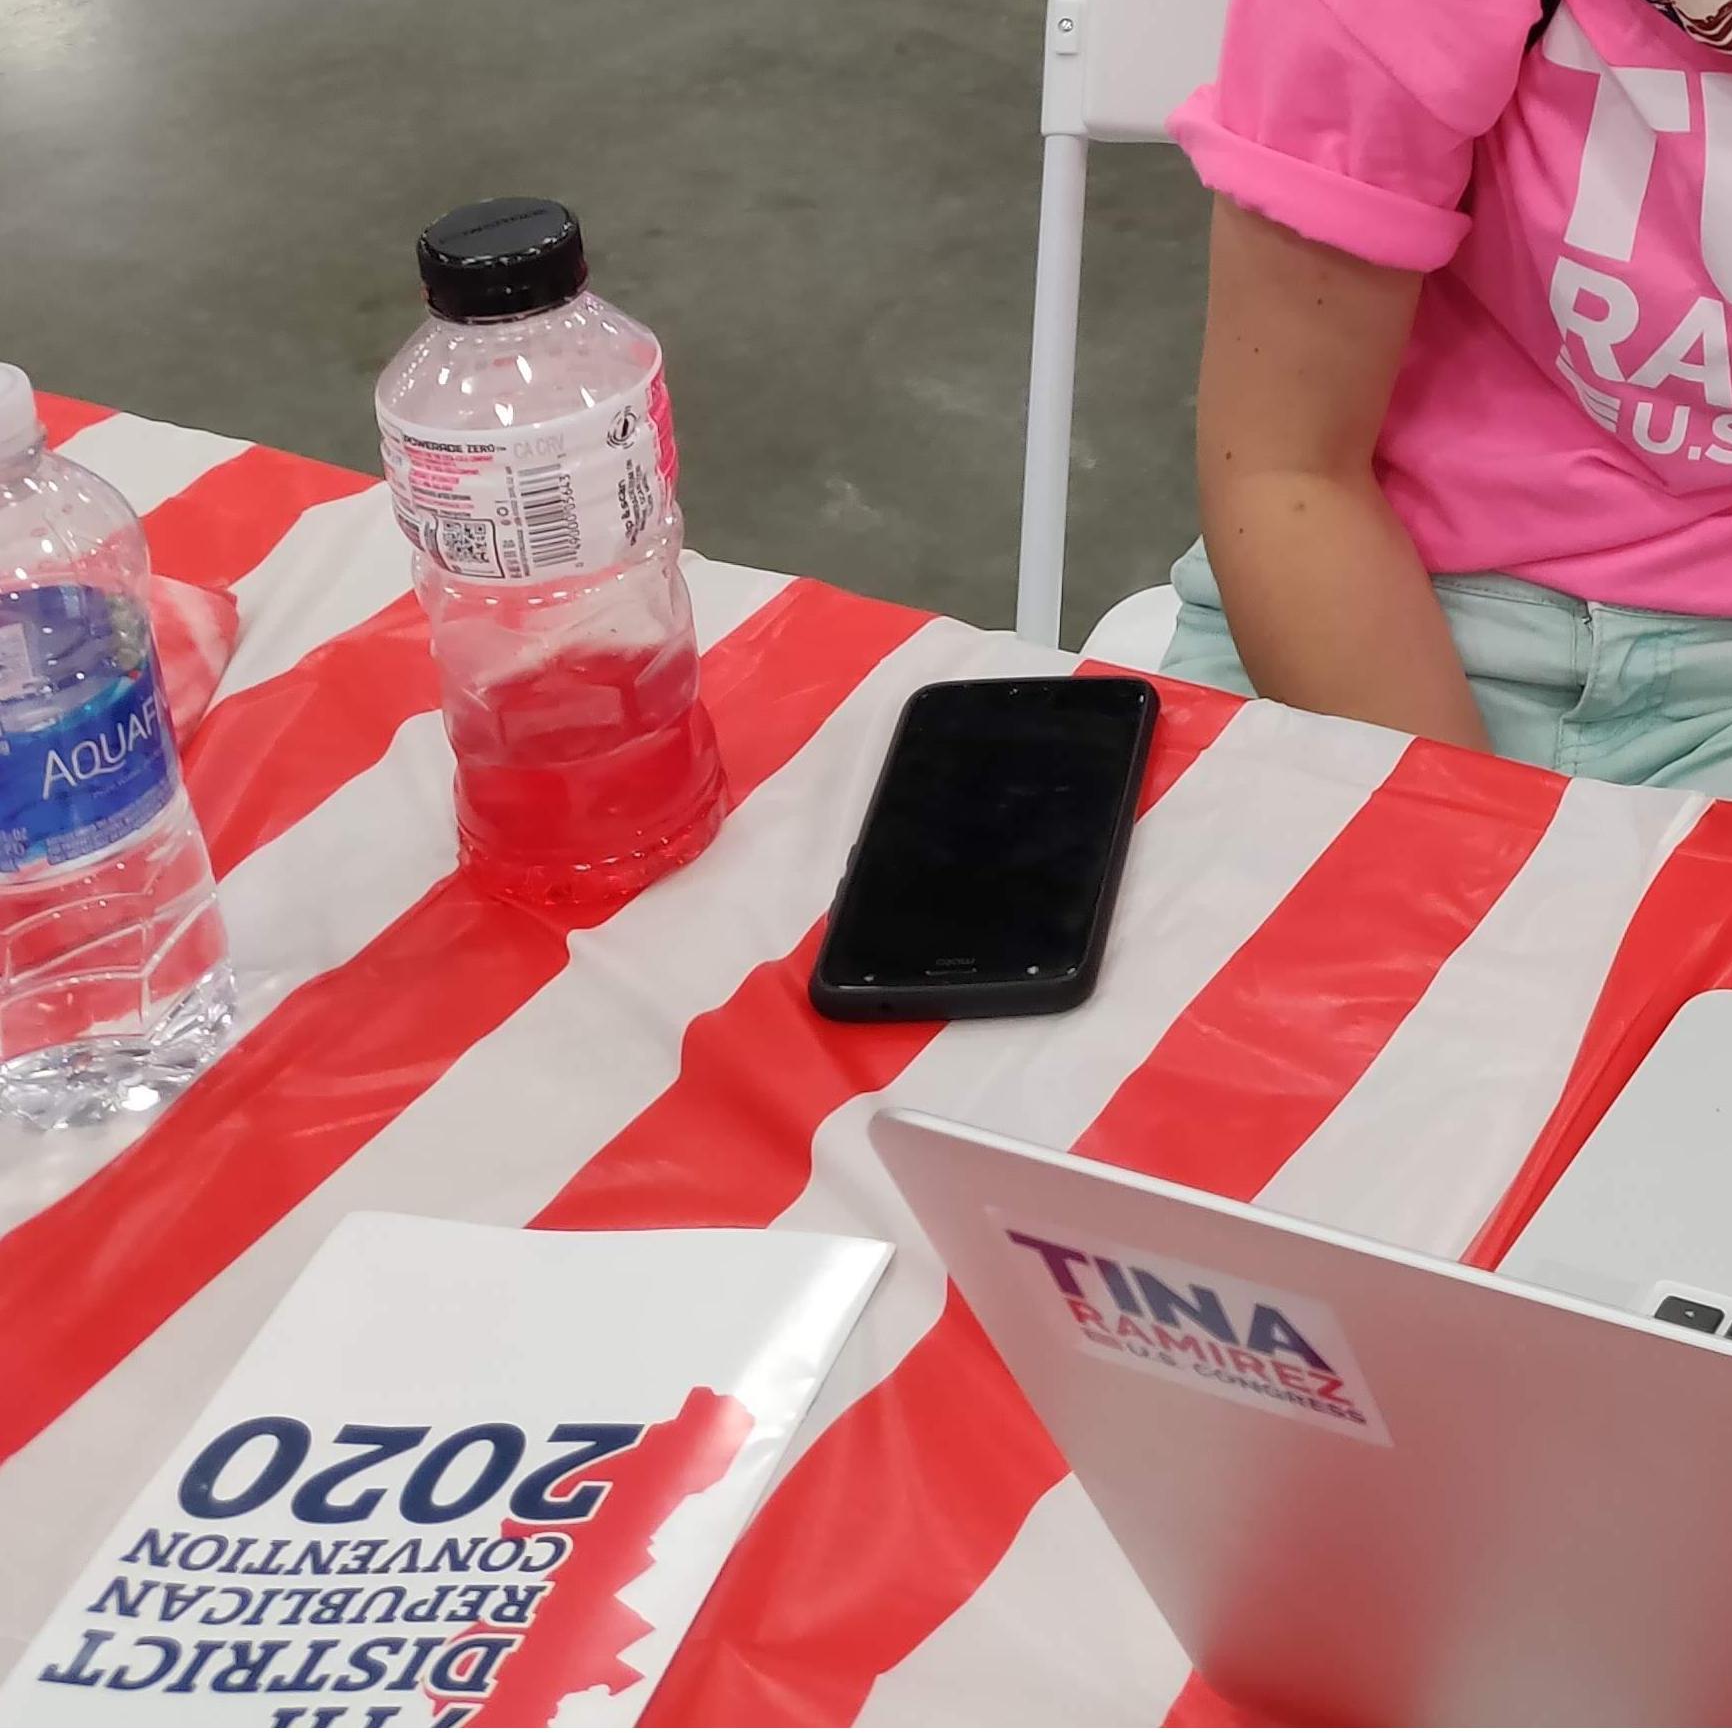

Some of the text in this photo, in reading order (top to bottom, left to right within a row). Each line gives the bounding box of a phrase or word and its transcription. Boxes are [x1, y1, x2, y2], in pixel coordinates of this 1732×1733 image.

[403, 434, 463, 454] POWERADE
[42, 696, 158, 800] AQUAF
[1006, 1229, 1337, 1374] TINA
[1066, 1294, 1355, 1407] RAMIREZ
[1193, 1363, 1368, 1425] CONGRESS
[177, 1414, 645, 1525] 2020
[120, 1527, 568, 1576] CONVENTION
[86, 1576, 549, 1625] REPUBLICAN
[38, 1629, 517, 1695] DISTRICT
